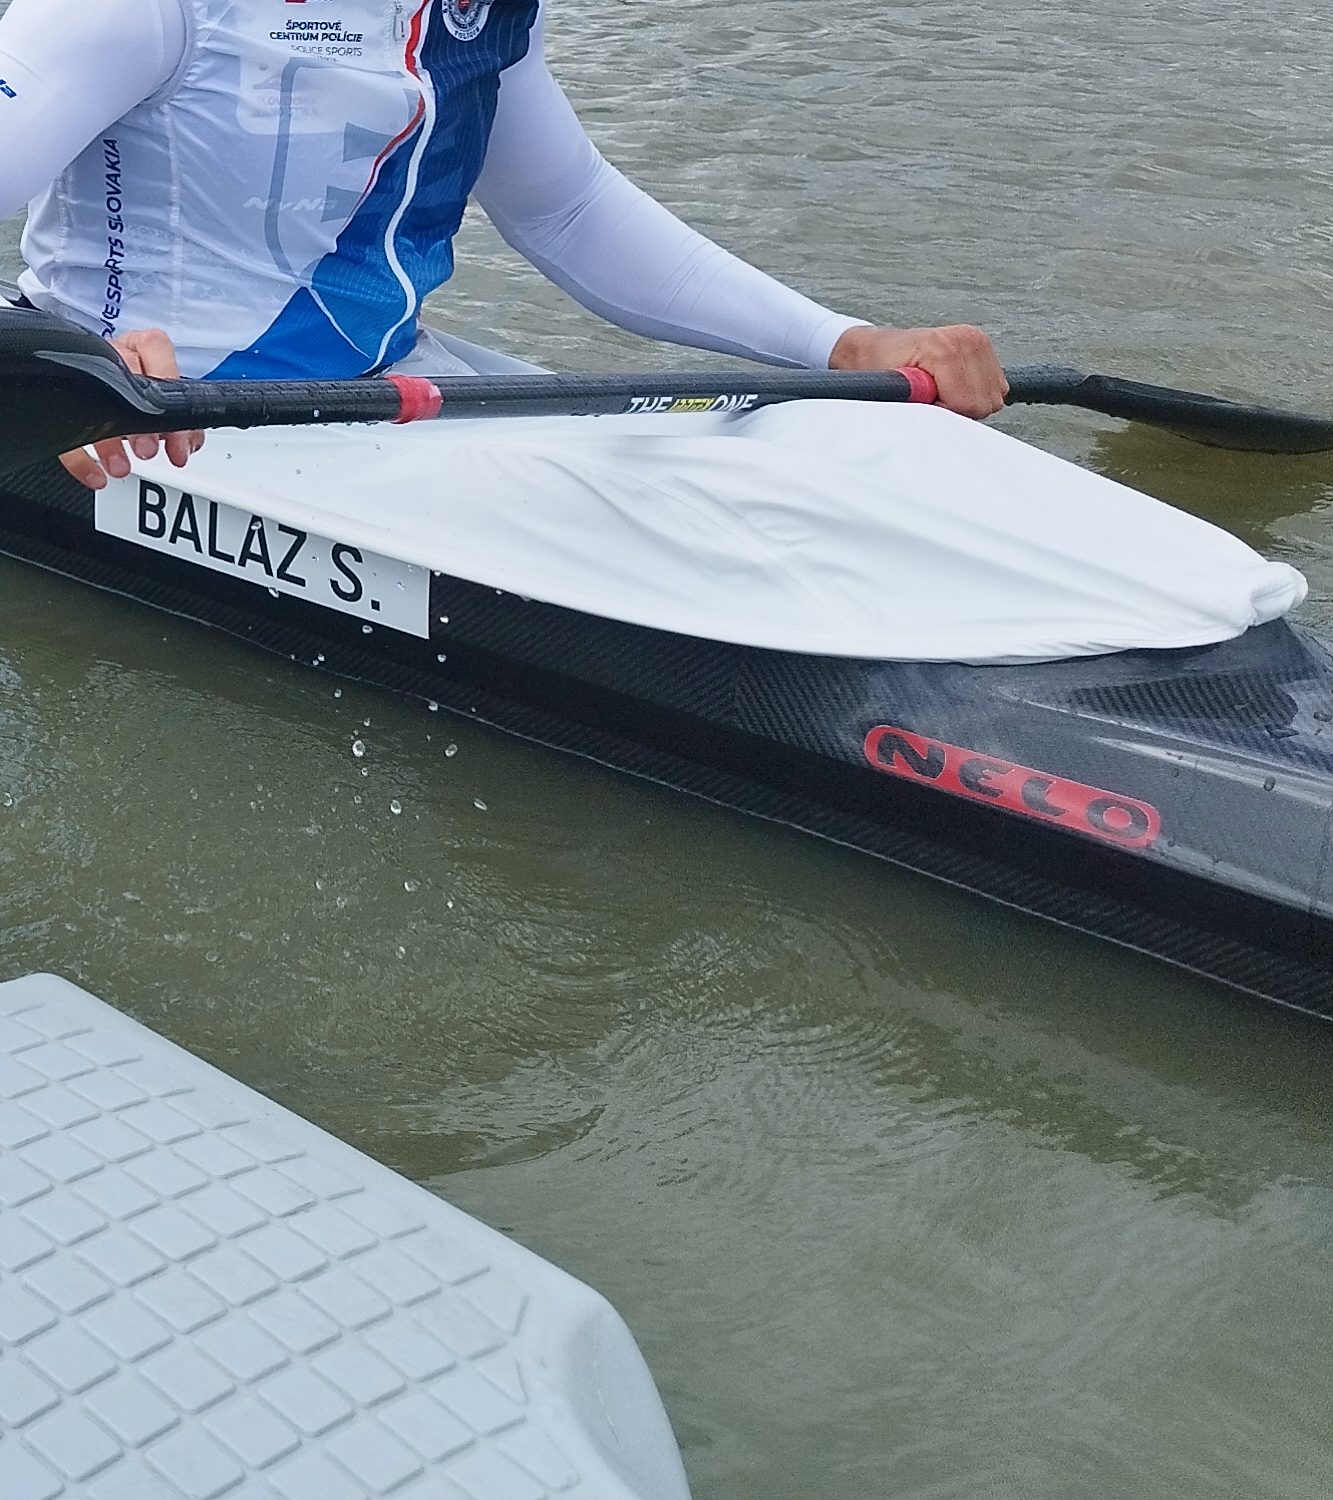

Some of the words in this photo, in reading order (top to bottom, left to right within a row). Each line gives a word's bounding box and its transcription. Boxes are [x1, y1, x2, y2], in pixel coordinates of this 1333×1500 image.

[270, 31, 319, 41] CENTRUM
[322, 31, 363, 42] POLÍCIE
[286, 19, 342, 31] ŠPORTOVÉ
[325, 46, 363, 57] SPORTS
[102, 138, 124, 234] SLOVAKIA
[104, 237, 124, 304] SPORTS
[623, 396, 673, 414] THE
[708, 394, 759, 411] ONE
[137, 478, 308, 589] BALAZ
[329, 541, 382, 612] S.
[876, 731, 1150, 839] NELO
